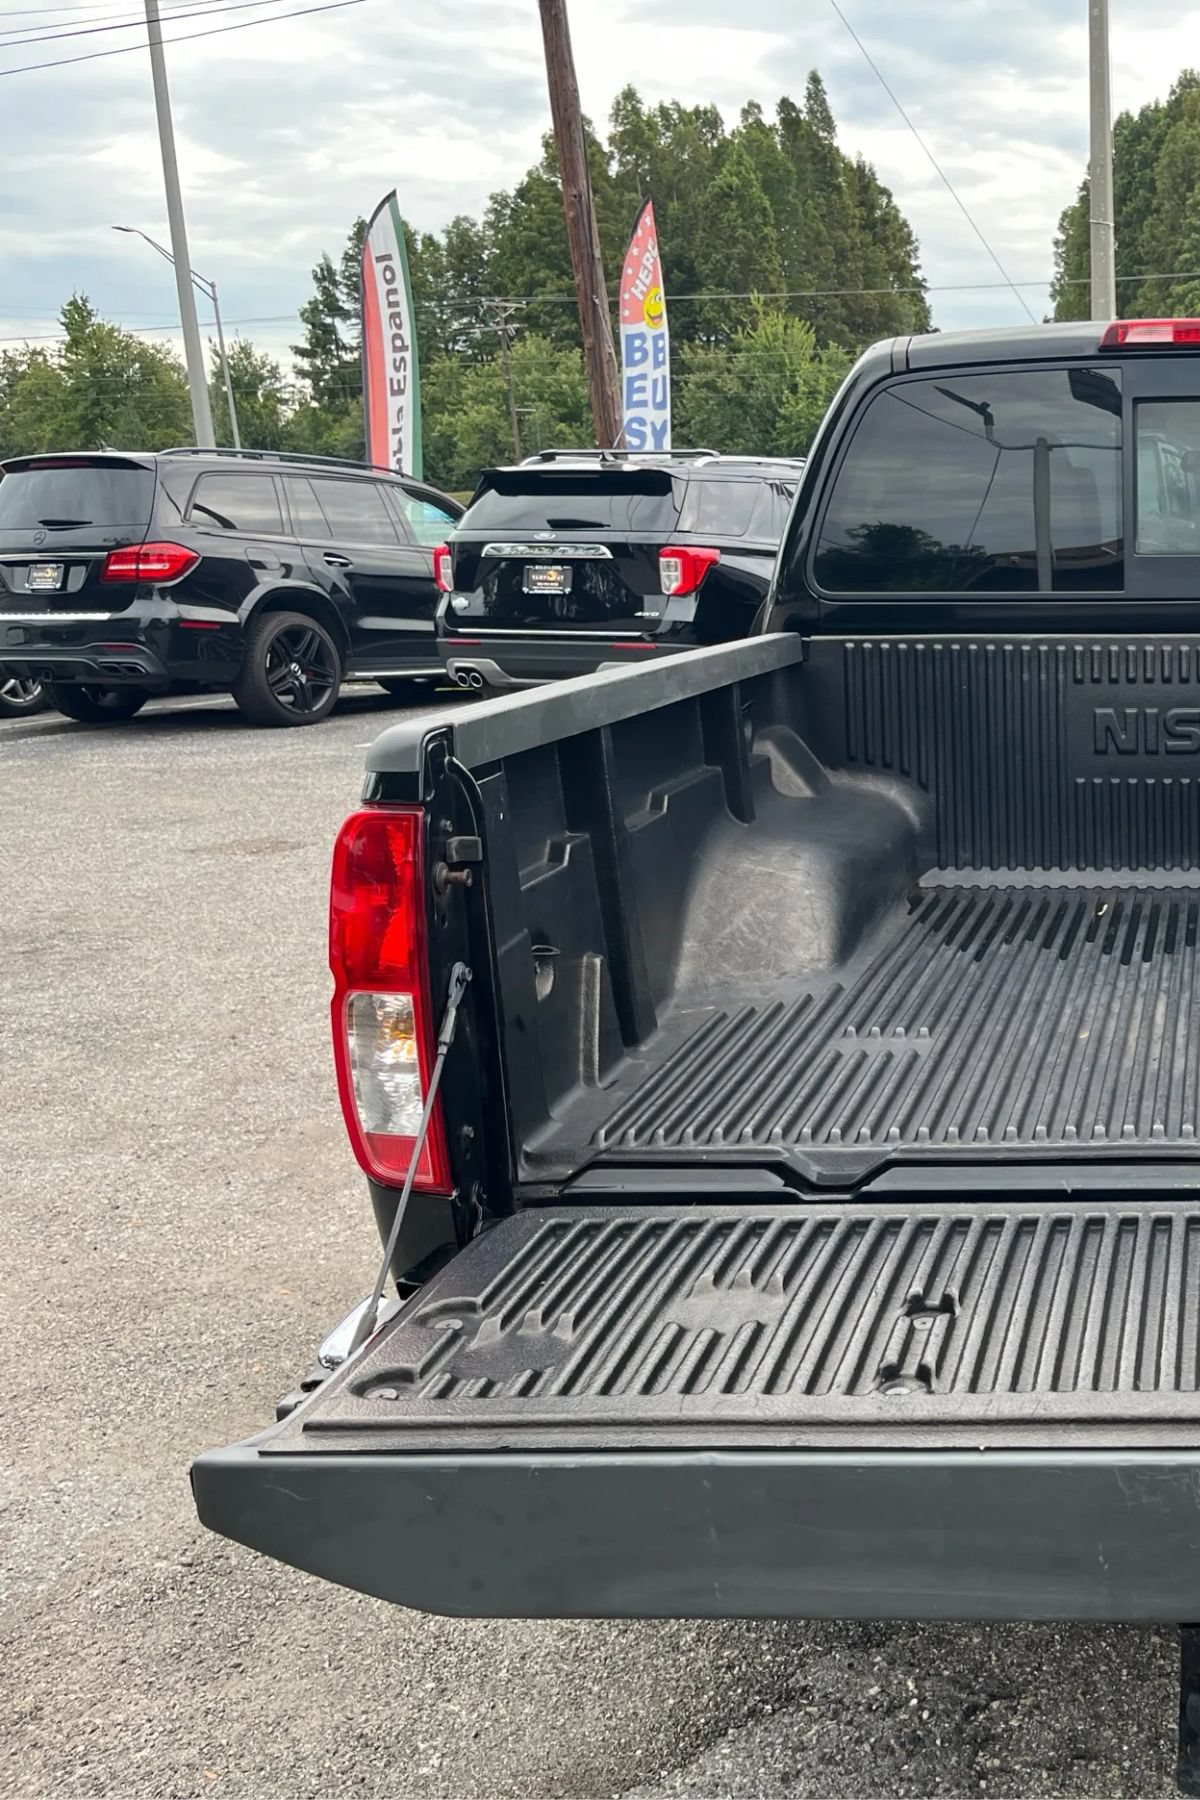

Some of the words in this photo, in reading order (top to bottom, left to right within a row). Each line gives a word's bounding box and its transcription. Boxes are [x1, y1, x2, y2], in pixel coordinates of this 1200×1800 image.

[375, 253, 410, 396] Espanol
[630, 236, 660, 302] HERE
[622, 332, 650, 451] BES
